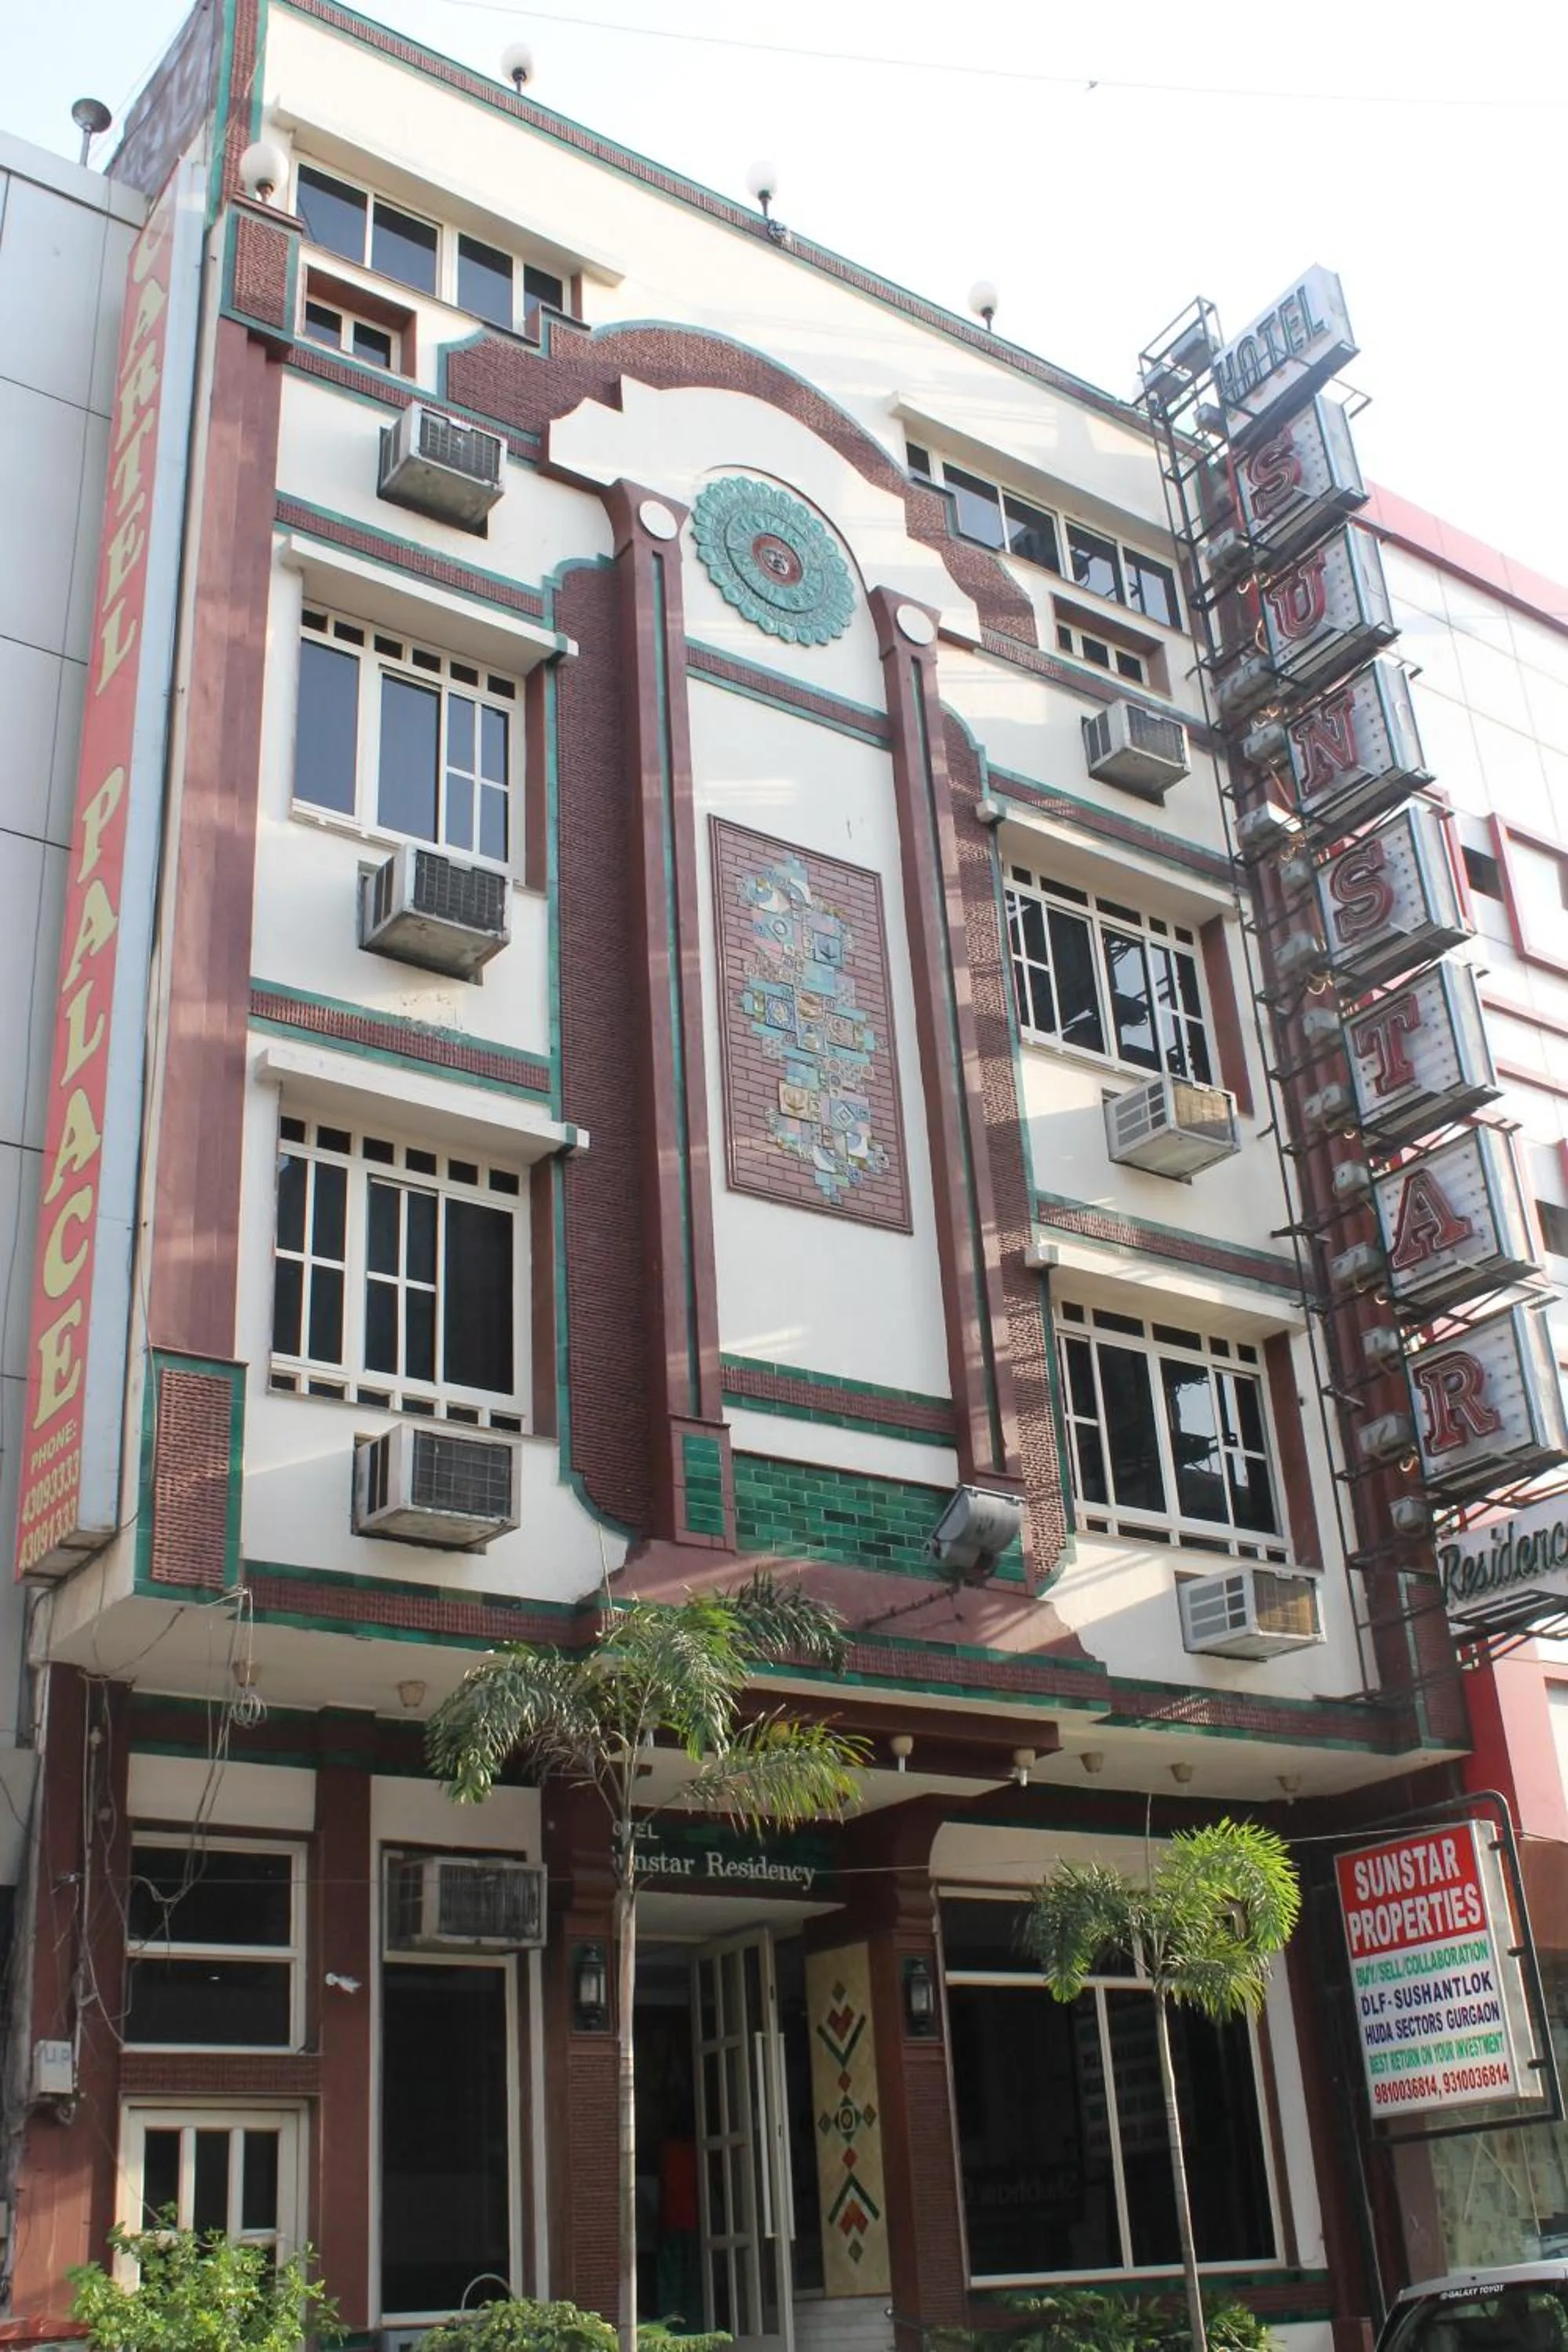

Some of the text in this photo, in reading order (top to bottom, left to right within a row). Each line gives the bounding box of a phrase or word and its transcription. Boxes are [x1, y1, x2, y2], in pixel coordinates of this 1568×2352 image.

[1214, 284, 1324, 403] HOTEL
[1247, 424, 1501, 1457] SUNSTAR
[33, 765, 125, 1430] PALACE
[31, 1417, 77, 1475] PHONE:
[1439, 1519, 1568, 1601] Residenc
[705, 1850, 815, 1890] Residency
[1354, 1838, 1461, 1901] SUNSTAR
[1348, 1882, 1481, 1952] PROPERTIES
[1365, 2000, 1501, 2045] HUDA SECTORS GURGAON
[1369, 2031, 1504, 2075] BEST RETURN ON YOUR INVESTMENT
[1442, 2063, 1509, 2094] 9310036814
